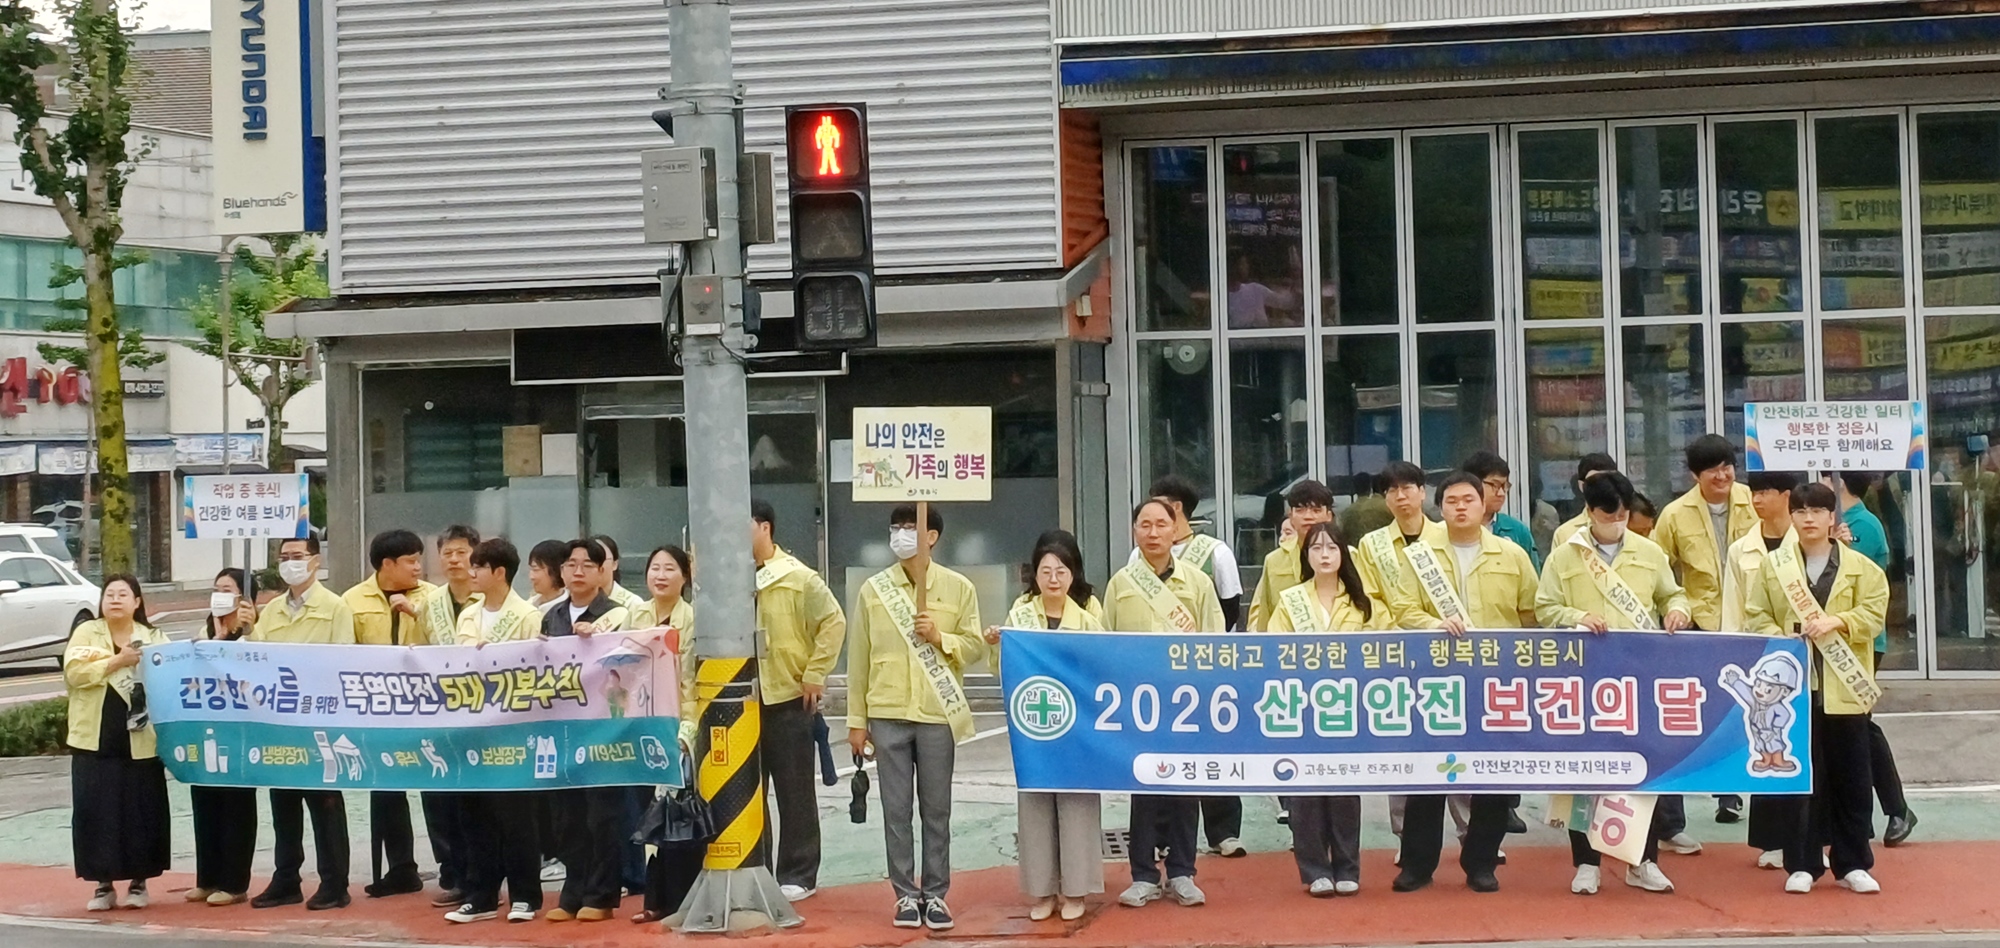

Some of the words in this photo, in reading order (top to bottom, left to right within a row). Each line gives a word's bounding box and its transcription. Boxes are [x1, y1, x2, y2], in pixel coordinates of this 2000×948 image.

[240, 0, 268, 141] YUNDAI
[223, 196, 287, 209] Bluehands
[1763, 405, 1819, 419] 안전하고
[1826, 405, 1868, 419] 건강한
[866, 423, 895, 449] 나의
[901, 423, 945, 449] 안전은
[1787, 422, 1830, 435] 행복한
[1836, 422, 1879, 435] 정읍시
[1773, 439, 1830, 452] 우리모두
[1837, 438, 1894, 452] 함께해요
[905, 454, 948, 480] 가족의
[954, 453, 985, 480] 행복
[199, 505, 232, 521] 건강한
[236, 504, 258, 520] 여름
[1169, 642, 1264, 670] 안전하고
[1277, 641, 1348, 669] 건강한
[1361, 641, 1417, 671] 일터,
[1429, 638, 1501, 668] 행복한
[1513, 638, 1585, 668] 정읍시
[179, 673, 250, 710] 건강한
[252, 667, 312, 714] 여름을
[315, 695, 339, 714] 위한
[340, 671, 440, 714] 폭염안전
[438, 671, 486, 713] 5대
[486, 663, 588, 712] 기본수칙
[1094, 683, 1239, 733] 2026
[1256, 677, 1466, 737] 산업안전
[1482, 676, 1638, 736] 보건의
[1655, 676, 1707, 736] 달
[262, 745, 308, 765] 냉방장치
[482, 746, 527, 766] 보냉장구
[589, 742, 637, 762] 119신고
[1181, 762, 1246, 781] 정읍시
[1305, 763, 1361, 776] 고용노동부
[1367, 763, 1415, 776] 전주지청
[1472, 759, 1551, 775] 안전보건공단
[1554, 759, 1633, 775] 전북지역본부
